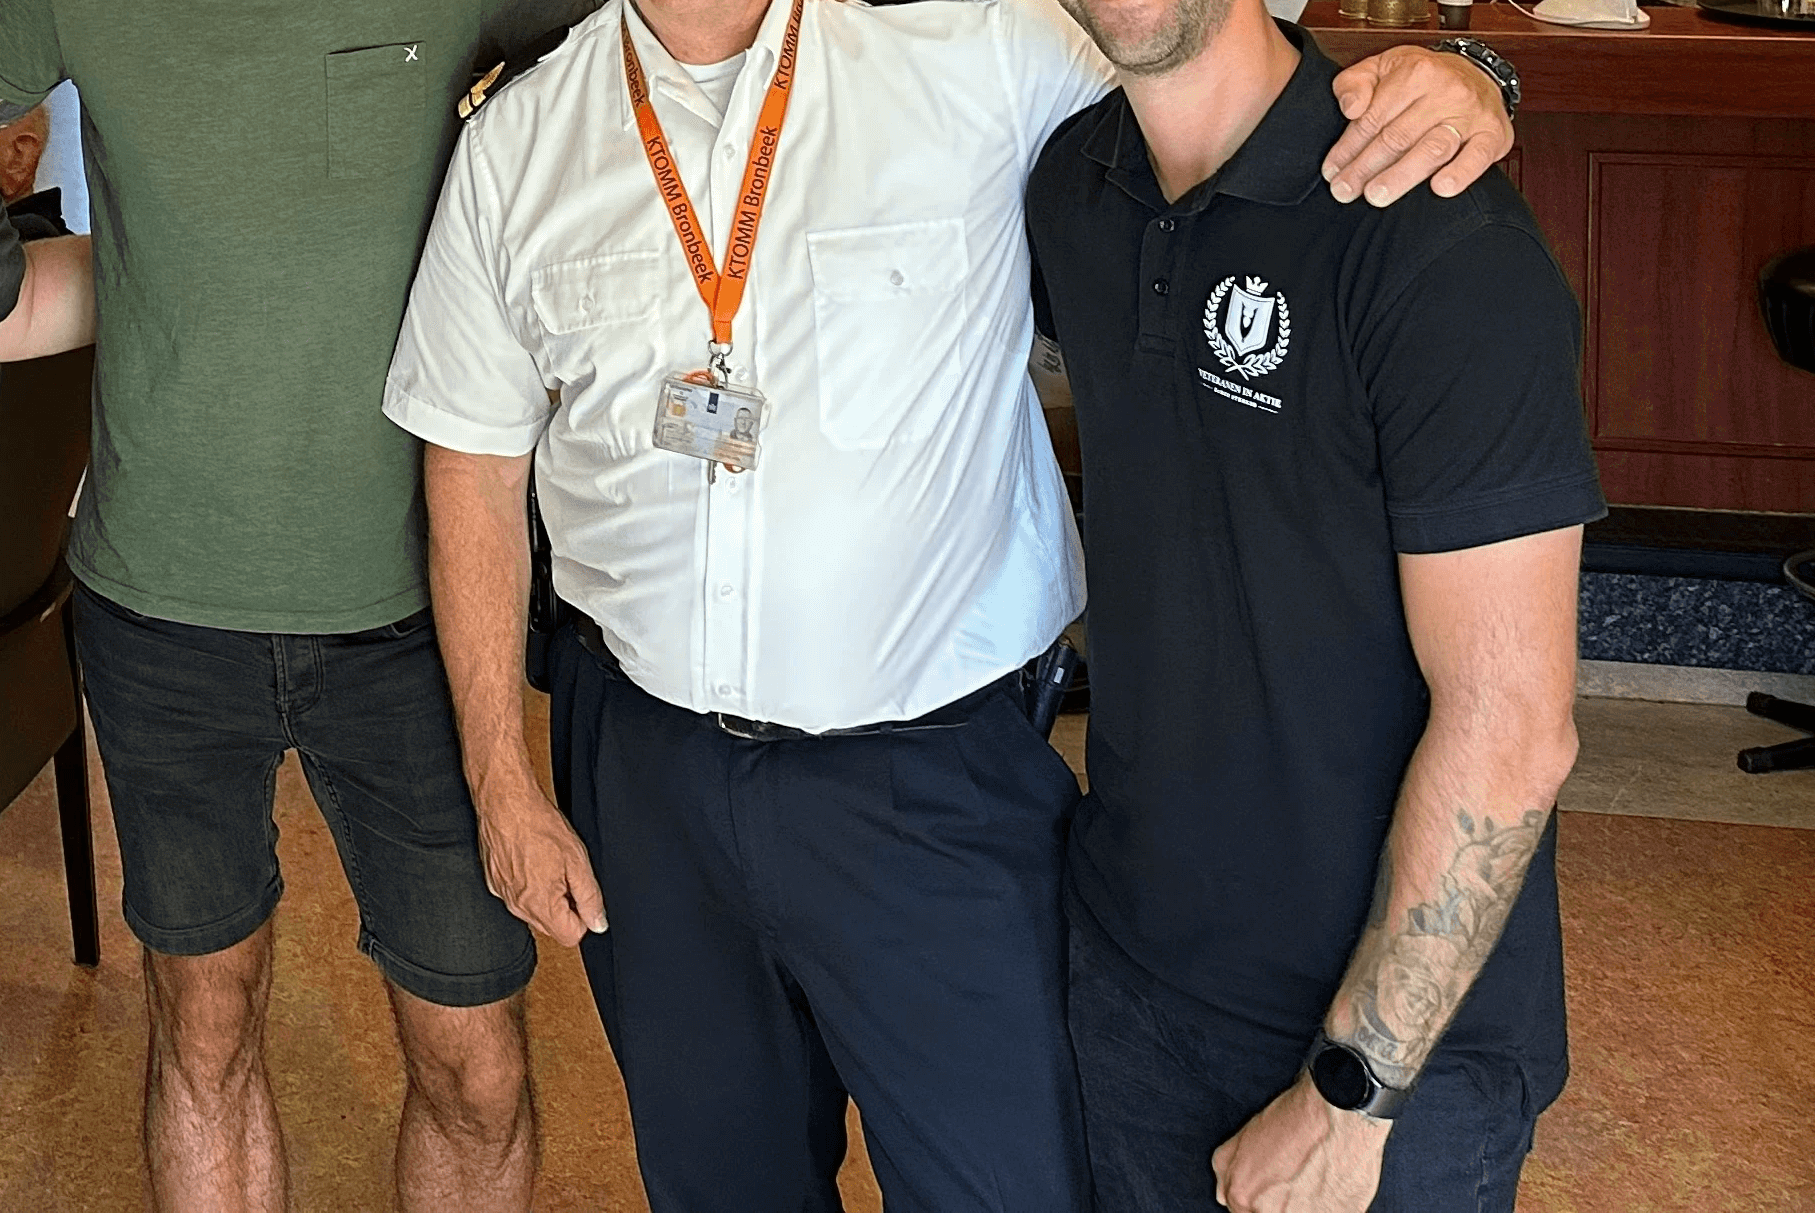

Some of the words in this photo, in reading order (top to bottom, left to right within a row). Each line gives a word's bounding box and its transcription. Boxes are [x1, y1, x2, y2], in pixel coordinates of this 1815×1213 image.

[646, 135, 682, 202] KTOMM
[672, 203, 714, 285] Bronbeek
[727, 210, 757, 279] KTOMM
[743, 125, 778, 207] Bronbeek
